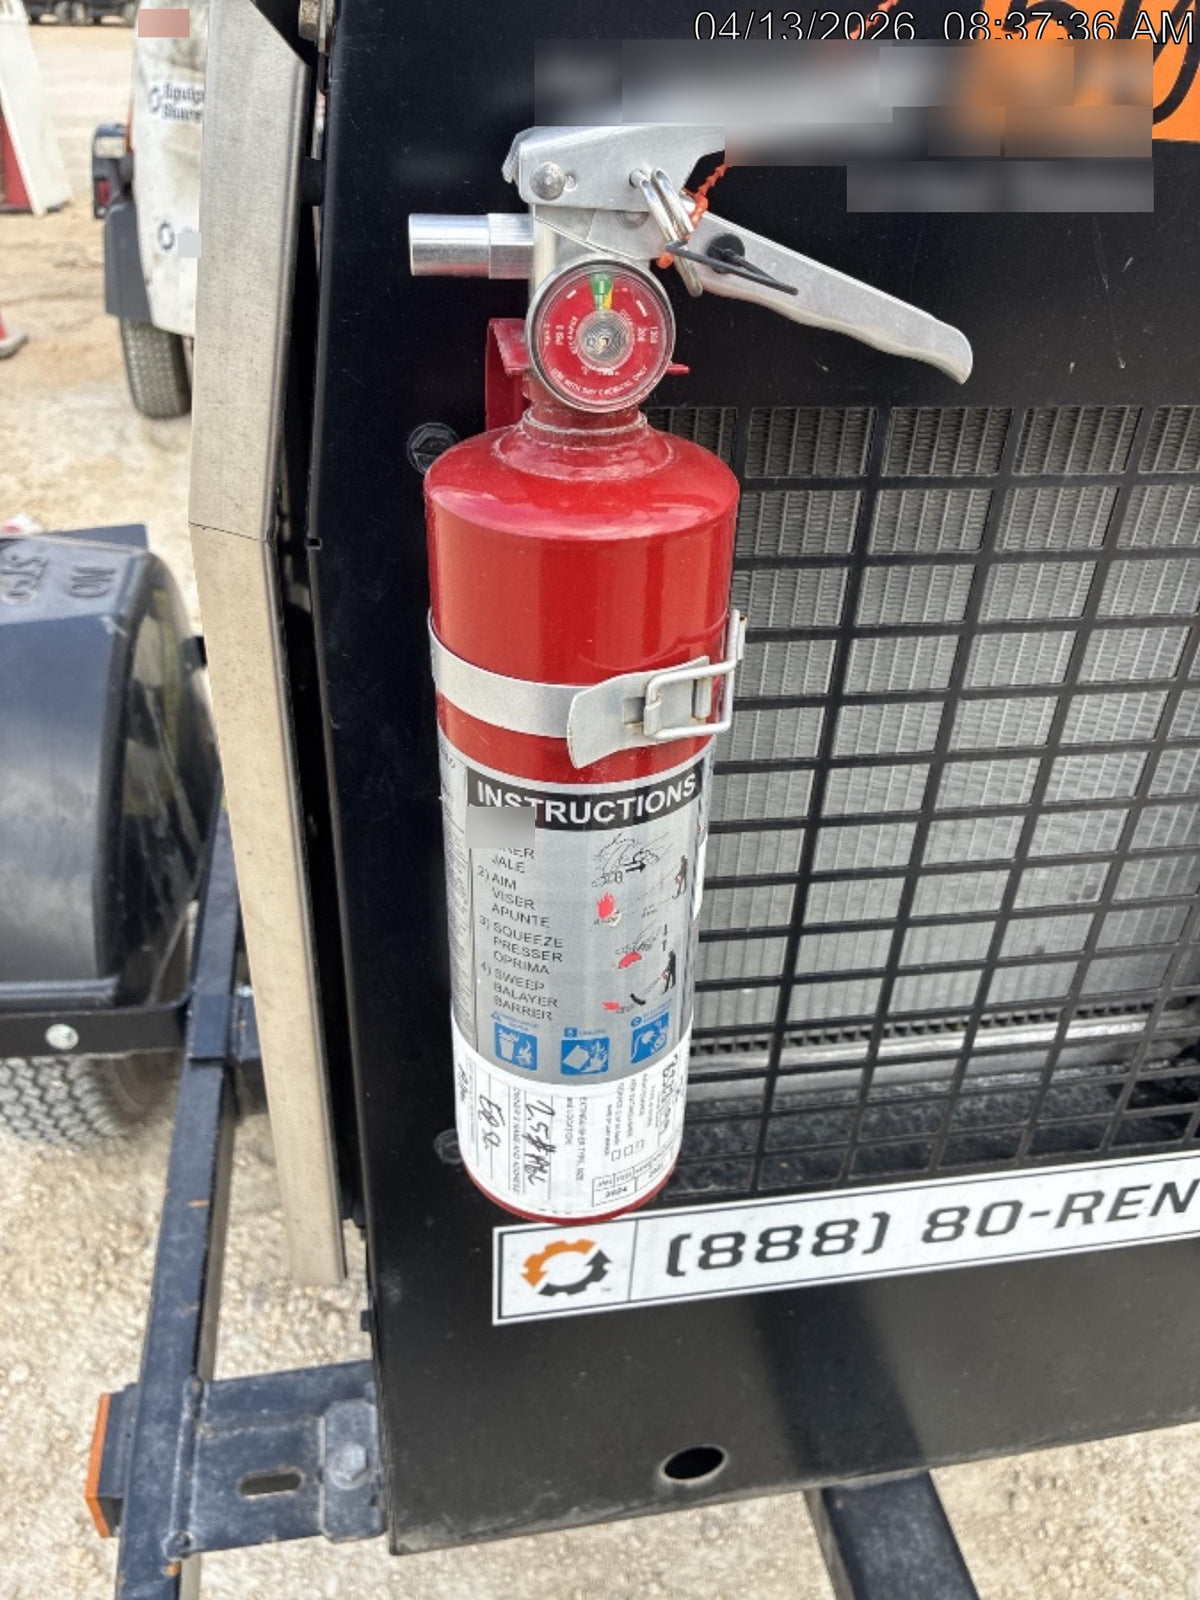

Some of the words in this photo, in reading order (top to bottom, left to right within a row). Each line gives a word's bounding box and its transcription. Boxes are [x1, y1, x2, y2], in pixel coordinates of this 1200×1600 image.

[477, 772, 697, 825] INSTRUCTIONS
[491, 854, 526, 874] JALE
[491, 872, 517, 891] AIM
[491, 886, 536, 911] VISER
[491, 903, 550, 929] APUNTE
[493, 921, 563, 949] SQUEEZE
[493, 935, 563, 963] PRESSER
[493, 950, 551, 975] OPRIMA
[494, 968, 545, 991] SWEEP
[493, 981, 559, 1009] BALAYER
[666, 1211, 891, 1277] (888)
[921, 1178, 1200, 1243] 80-REN
